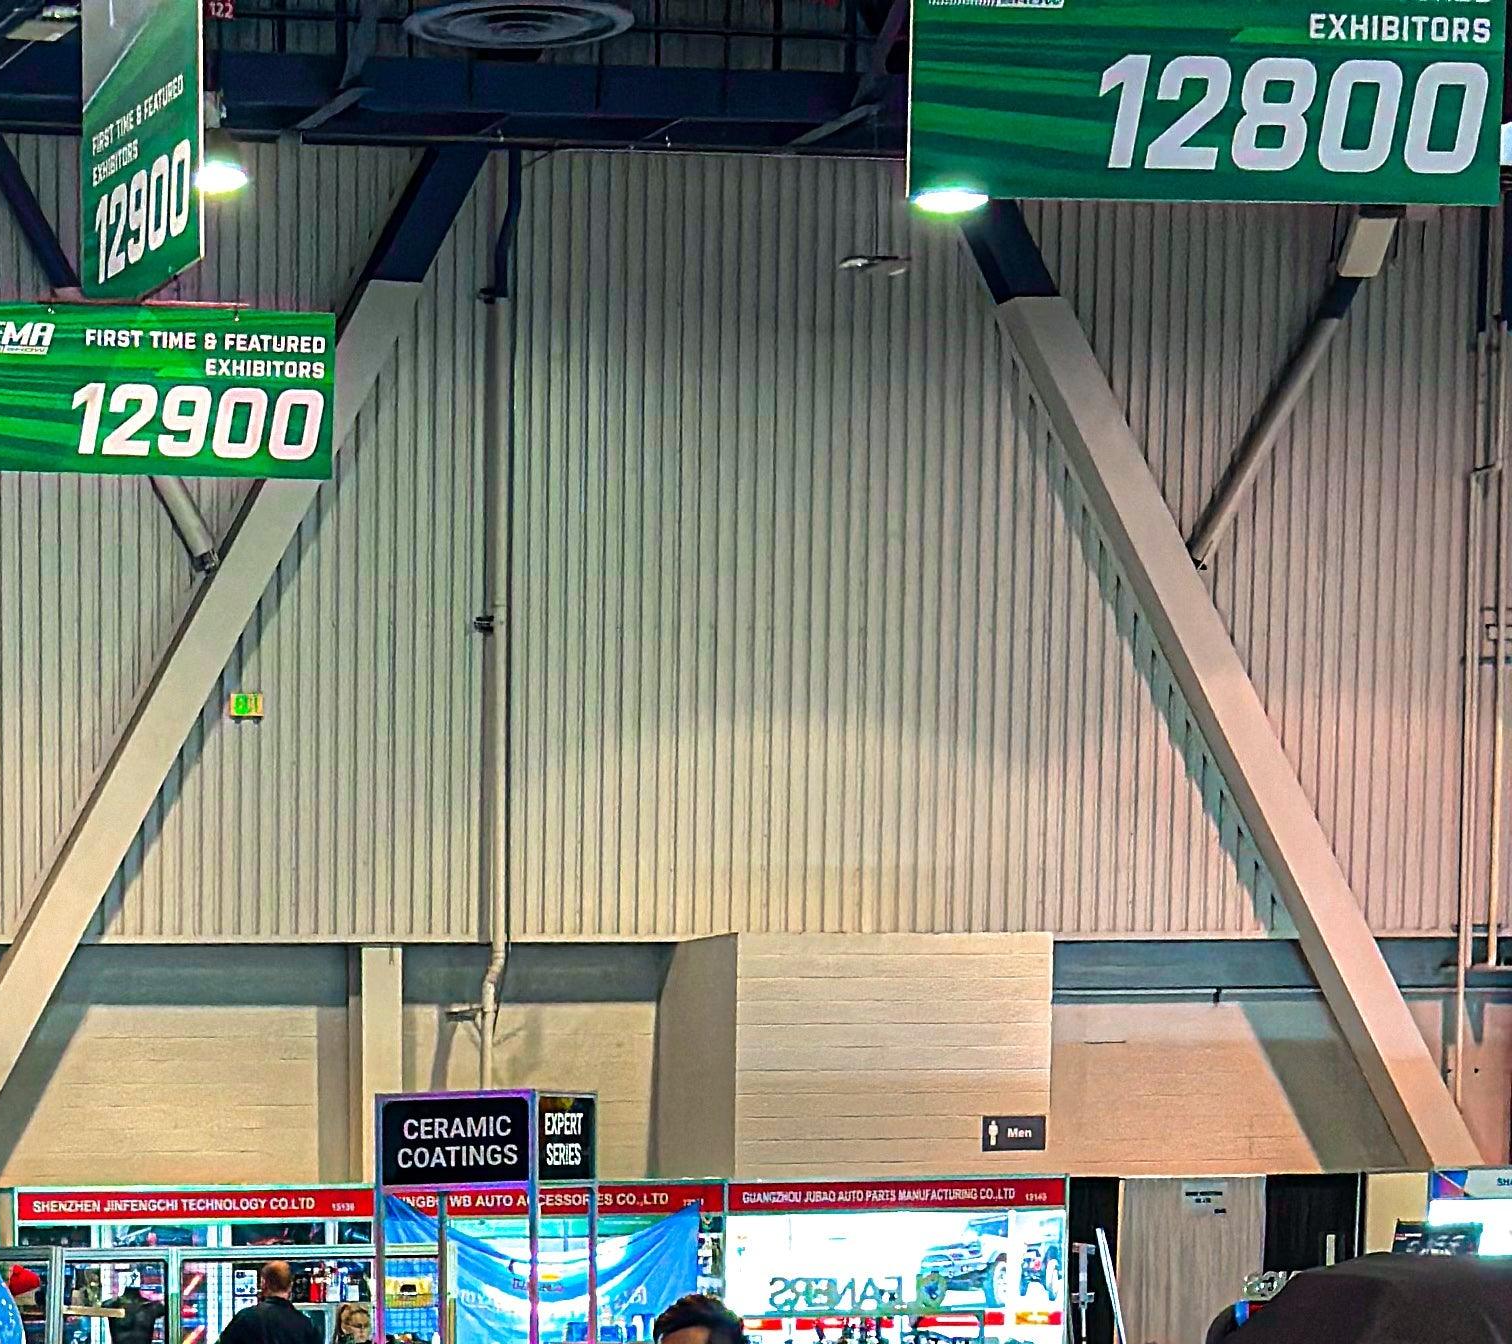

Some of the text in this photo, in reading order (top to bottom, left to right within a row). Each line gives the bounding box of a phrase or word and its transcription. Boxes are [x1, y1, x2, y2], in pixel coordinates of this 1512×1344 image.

[1308, 13, 1491, 44] EXHIBITORS
[92, 123, 115, 156] FIRST
[116, 109, 134, 139] TIME
[143, 73, 184, 120] FEATURED
[1098, 53, 1489, 174] 12800
[92, 138, 139, 188] EXHIBITORS
[95, 139, 191, 285] 12900
[85, 328, 327, 354] FIRST TIME & FEATURED
[205, 358, 325, 379] EXHIBITORS
[71, 382, 325, 461] 12900
[403, 1115, 512, 1140] CERAMIC
[544, 1112, 584, 1136] EXPERT
[1007, 1127, 1033, 1138] Men
[397, 1144, 518, 1168] COATINGS
[546, 1143, 582, 1166] SERIES
[32, 1200, 101, 1213] SHENZHEN
[103, 1199, 178, 1212] JINFENGCHI
[182, 1198, 266, 1211] TECHNOLOGY
[449, 1195, 473, 1207] WB
[475, 1194, 513, 1207] AUTO
[516, 1193, 613, 1207] ACESSORES
[742, 1191, 801, 1204] GUANGZHOU
[838, 1190, 863, 1202] AUTO
[865, 1189, 896, 1202] PARTS
[897, 1188, 978, 1201] MANUFACTURING
